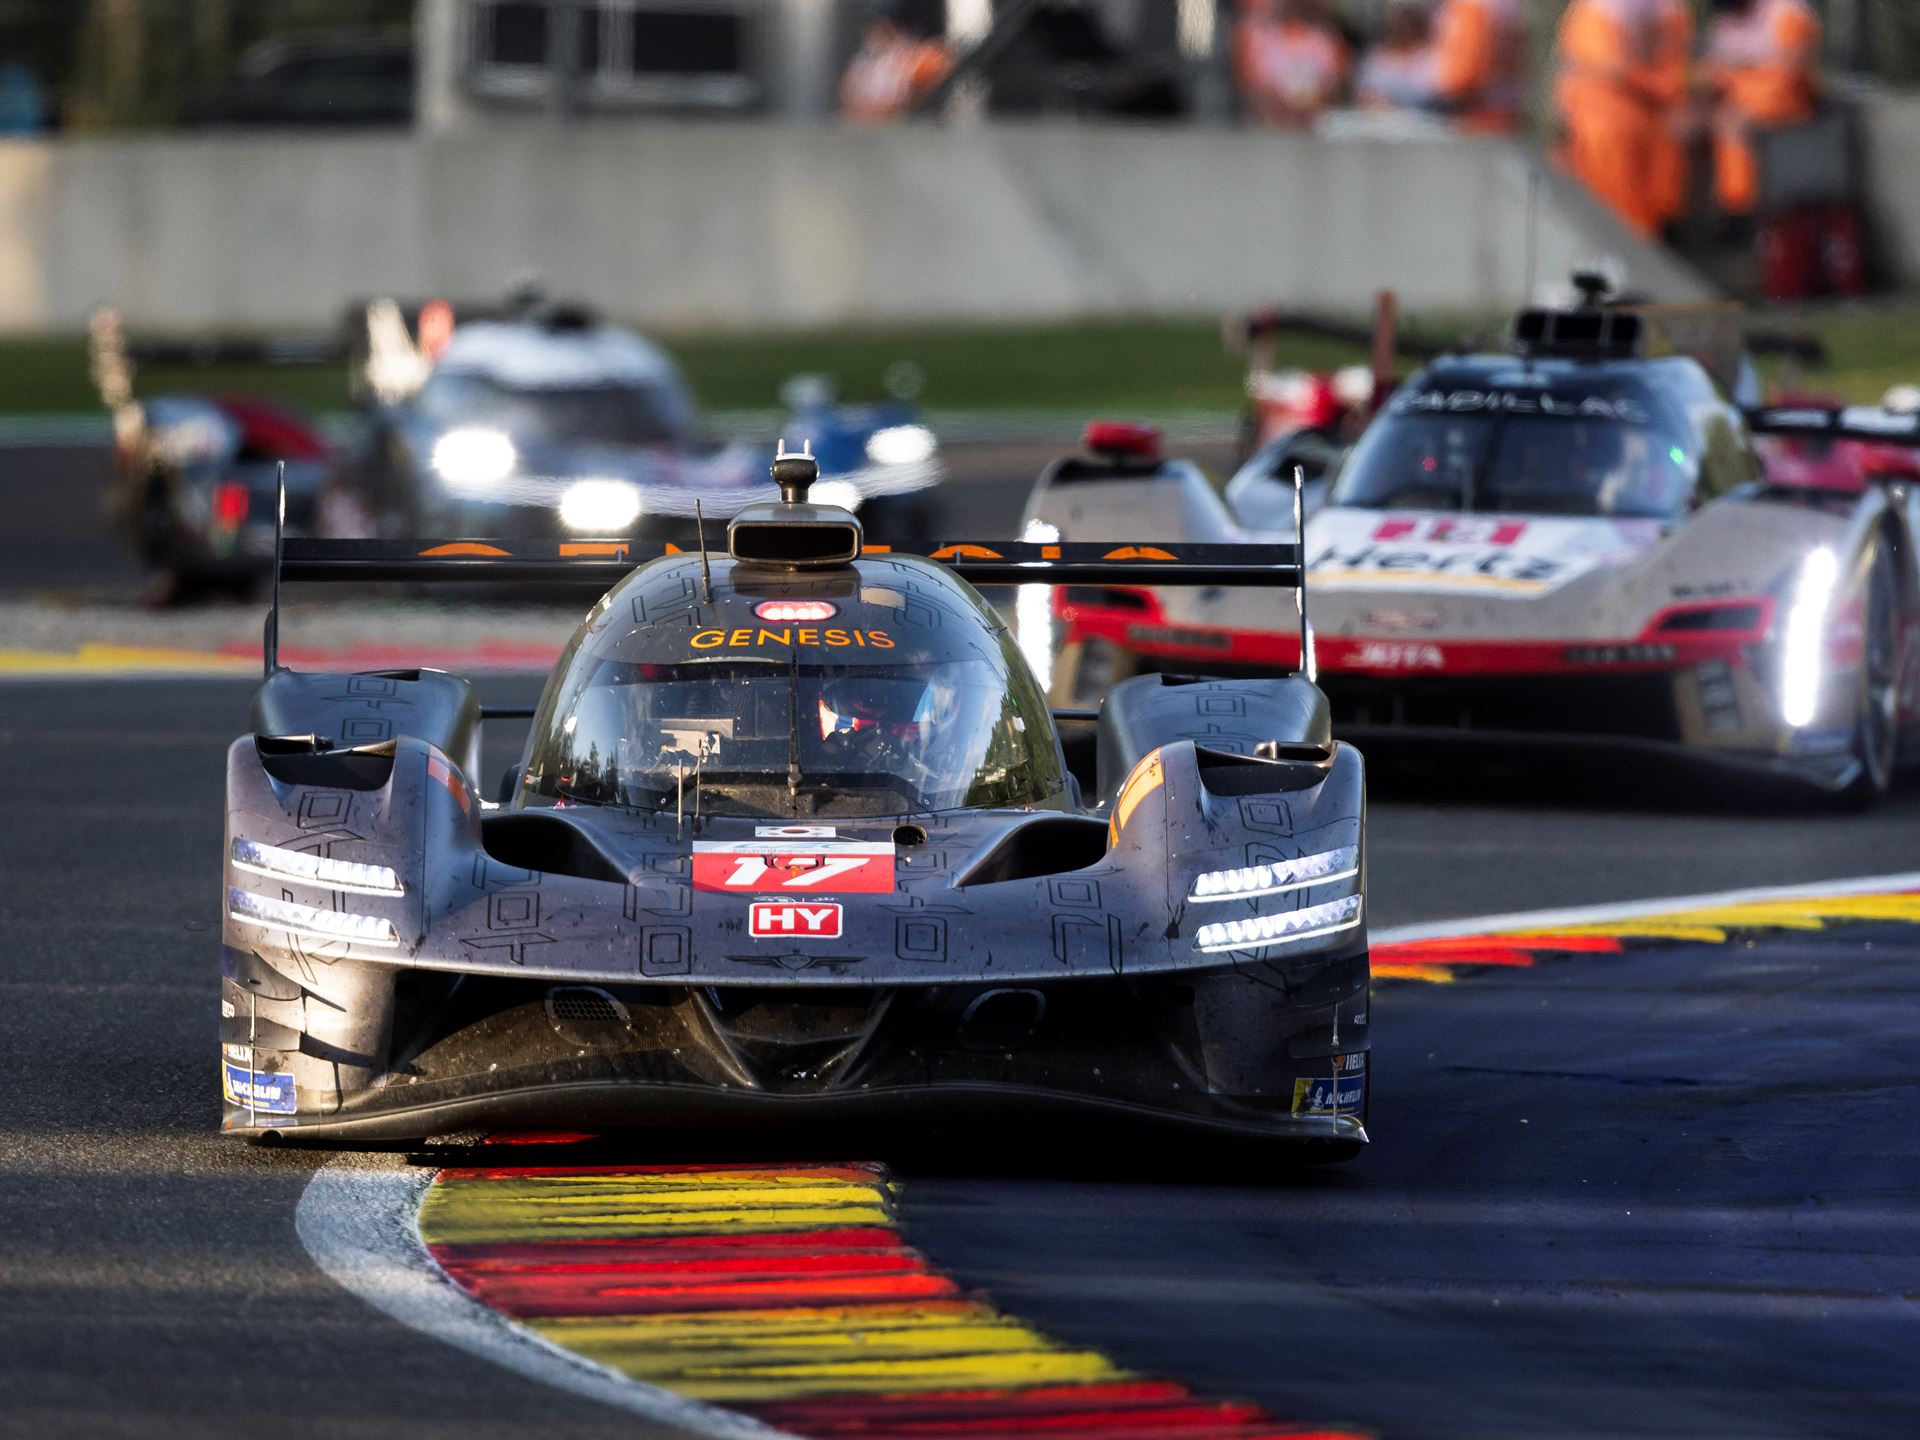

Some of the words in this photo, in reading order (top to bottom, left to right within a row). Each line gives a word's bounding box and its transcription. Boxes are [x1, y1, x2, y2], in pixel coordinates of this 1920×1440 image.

[689, 628, 896, 650] GENESIS
[723, 856, 871, 887] 17
[758, 907, 834, 931] HY
